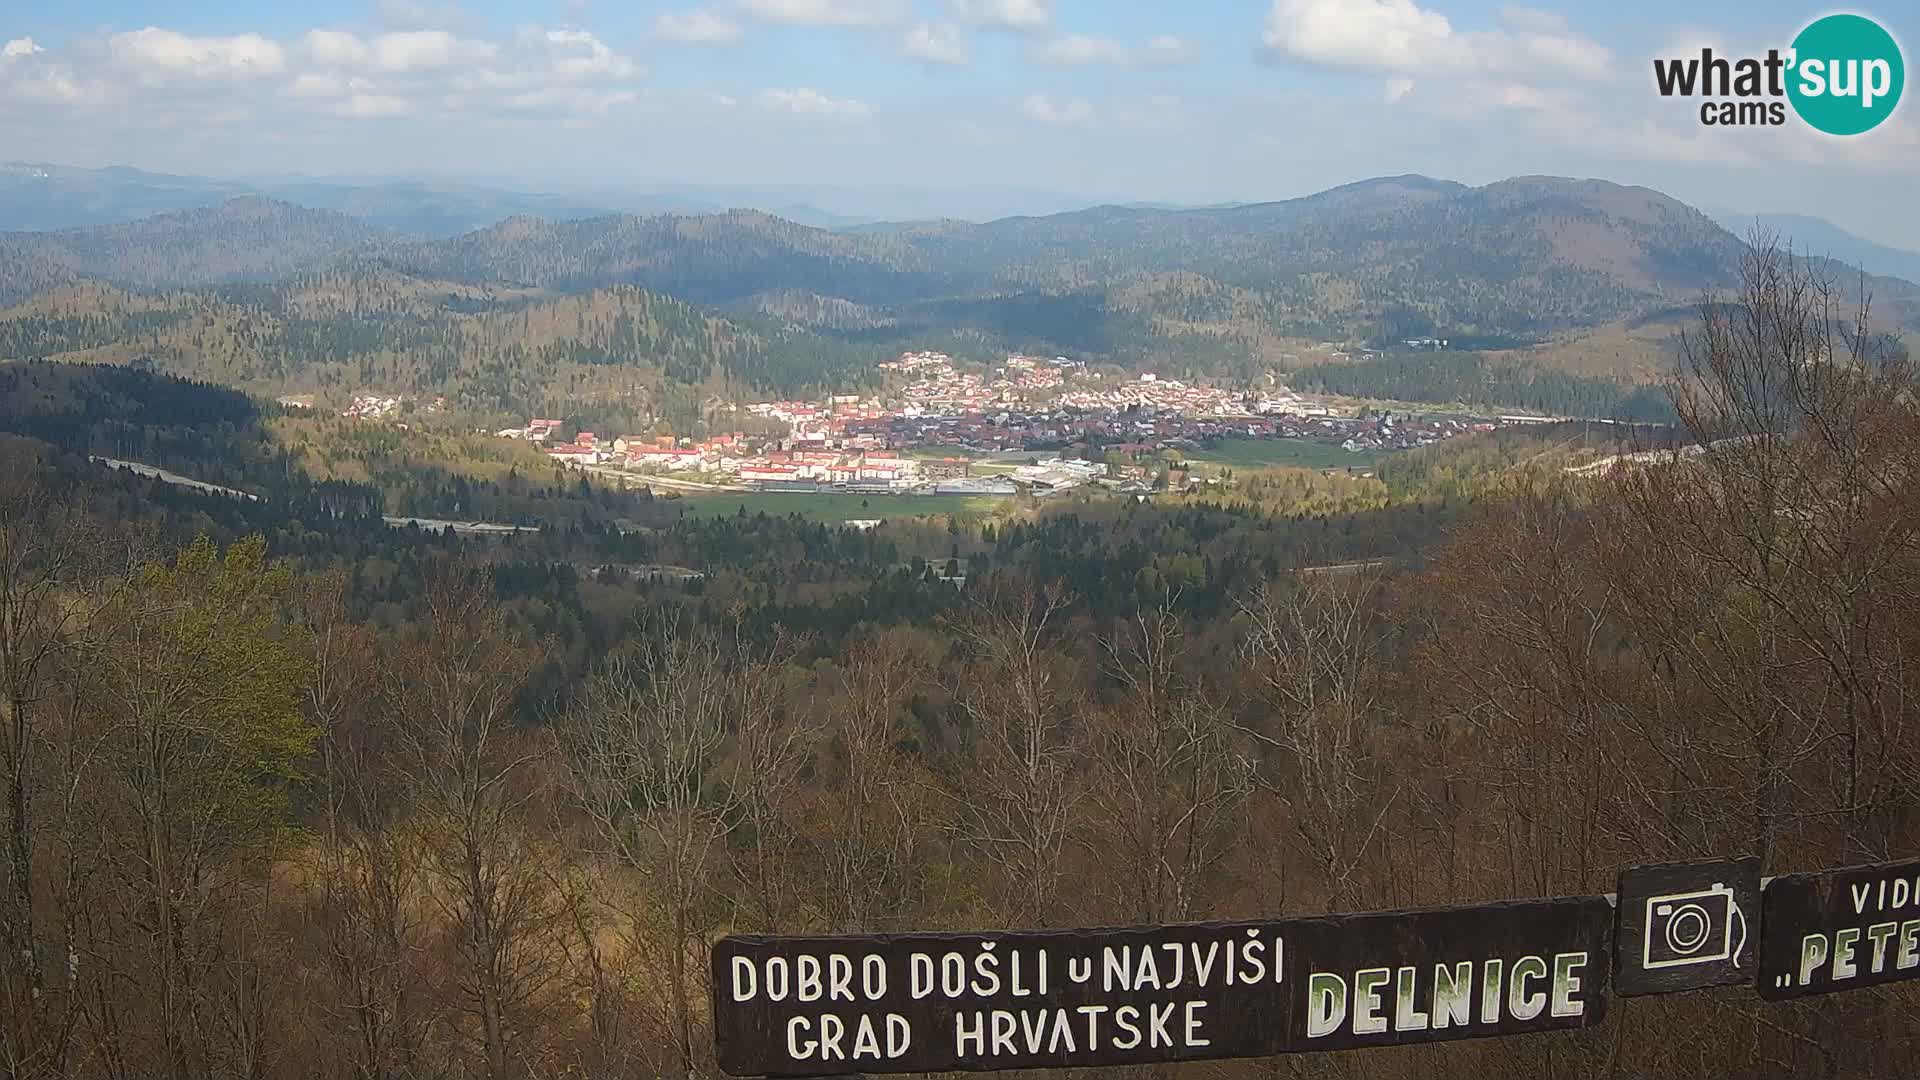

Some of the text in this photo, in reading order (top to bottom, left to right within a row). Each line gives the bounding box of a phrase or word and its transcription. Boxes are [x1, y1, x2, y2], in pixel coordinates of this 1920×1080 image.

[731, 954, 887, 1002] DOBRO
[910, 942, 1047, 999] DOŠLI
[1103, 928, 1284, 992] NAJVIŠI
[1307, 951, 1588, 1039] DELNICE
[787, 1001, 1211, 1060] GRAD HRVATSKE
